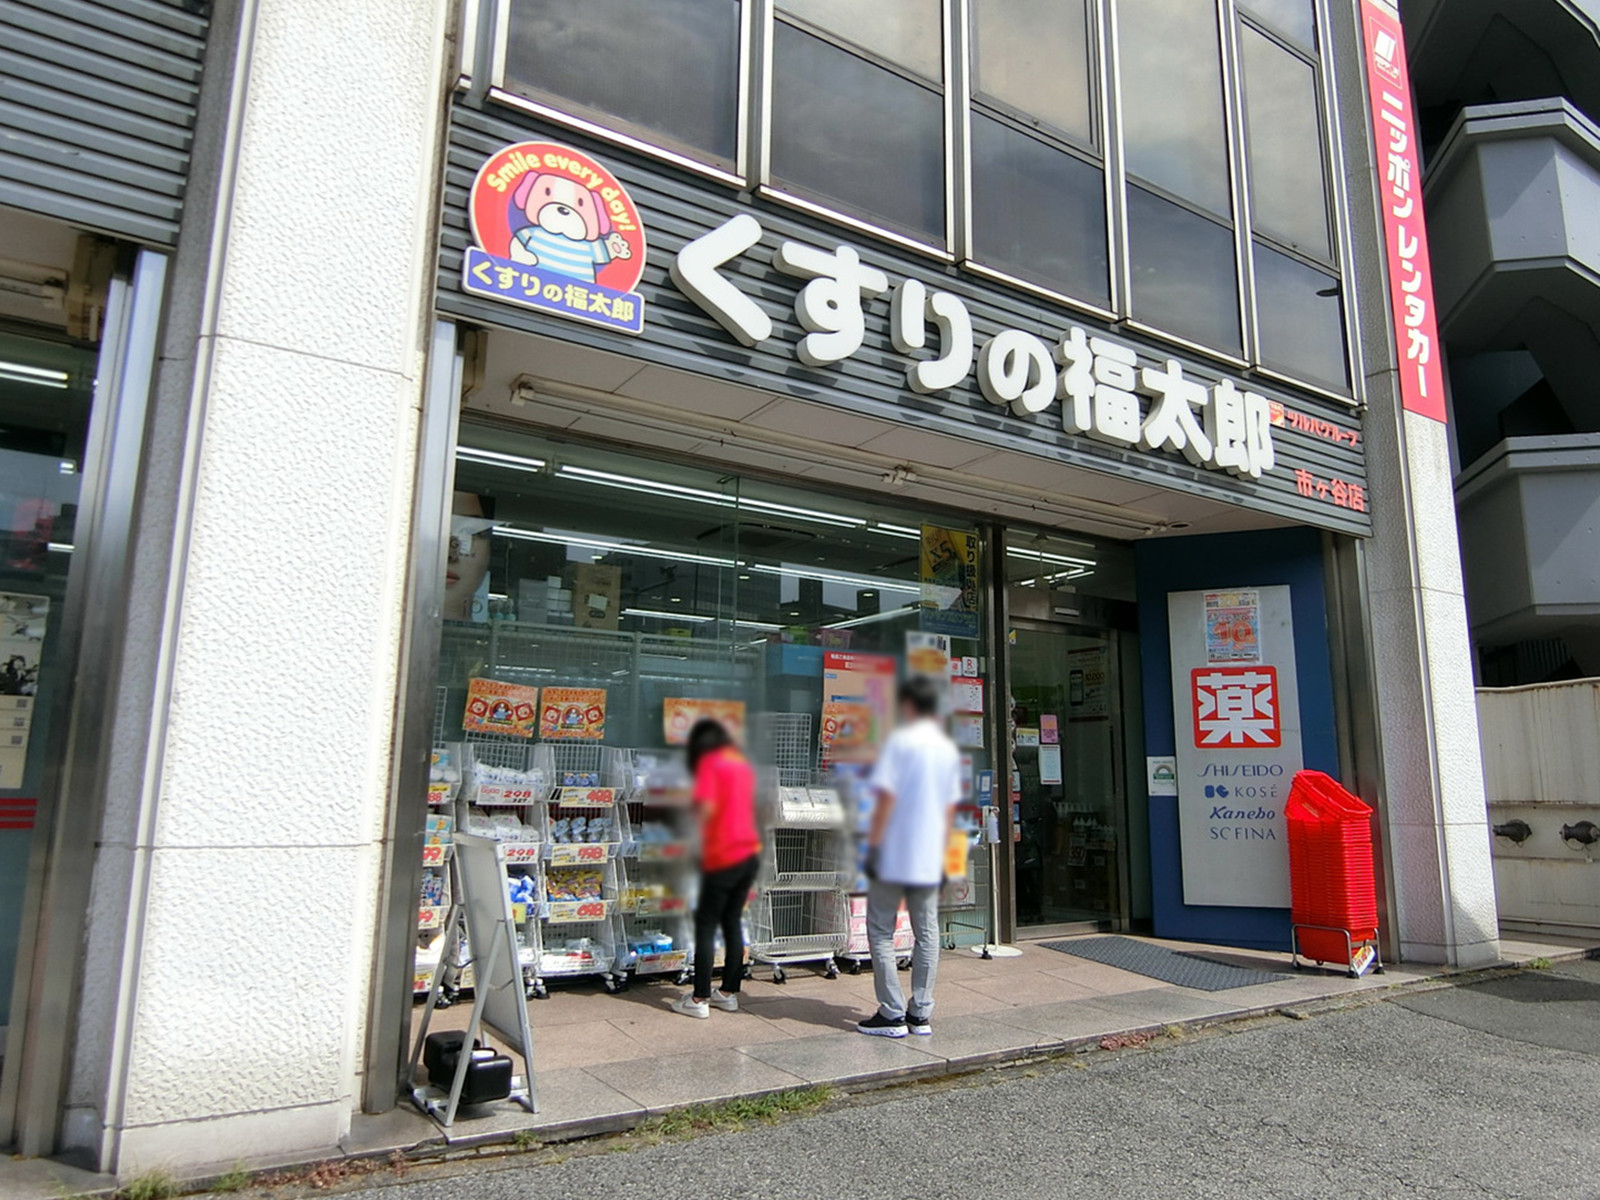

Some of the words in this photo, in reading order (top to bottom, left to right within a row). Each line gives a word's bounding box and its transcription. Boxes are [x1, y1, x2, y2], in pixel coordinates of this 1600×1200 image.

[486, 151, 541, 193] Smile
[543, 153, 604, 190] every
[601, 186, 636, 232] day!
[1380, 90, 1430, 398] ニッポンレンタカー
[472, 260, 634, 323] くすりの福太郎
[669, 213, 1275, 478] くすりの福太郎
[1196, 671, 1275, 744] 薬
[1198, 764, 1284, 777] SHISEIDO
[1209, 806, 1276, 821] Kanebo
